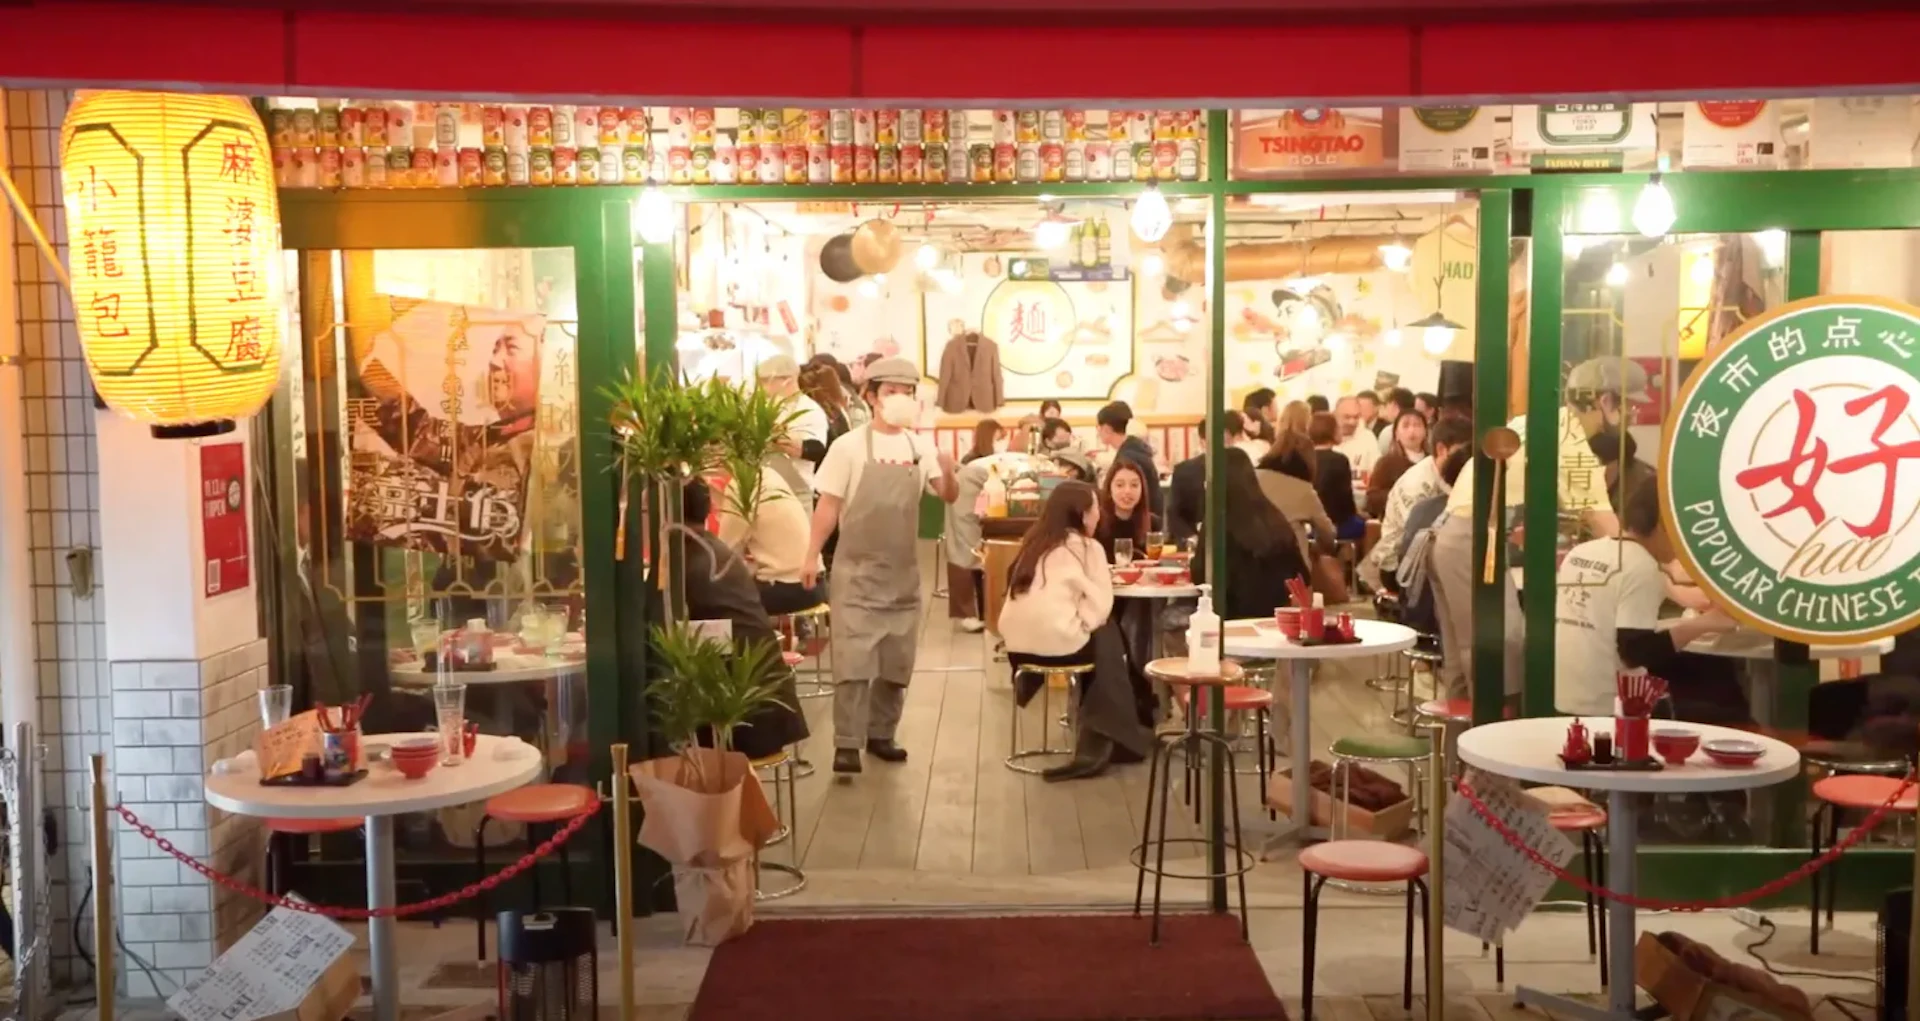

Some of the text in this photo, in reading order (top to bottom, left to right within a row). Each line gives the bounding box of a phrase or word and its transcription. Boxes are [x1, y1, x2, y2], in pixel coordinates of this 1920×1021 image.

[1258, 134, 1364, 155] TSINGTAO
[1287, 154, 1337, 166] GOLD
[77, 164, 130, 338] 小籠包
[218, 136, 266, 362] 麻婆豆腐
[1689, 315, 1915, 438] 夜市的点心
[1735, 383, 1920, 540] 好
[1683, 499, 1775, 606] POPULAR
[1776, 580, 1907, 625] CHINESE
